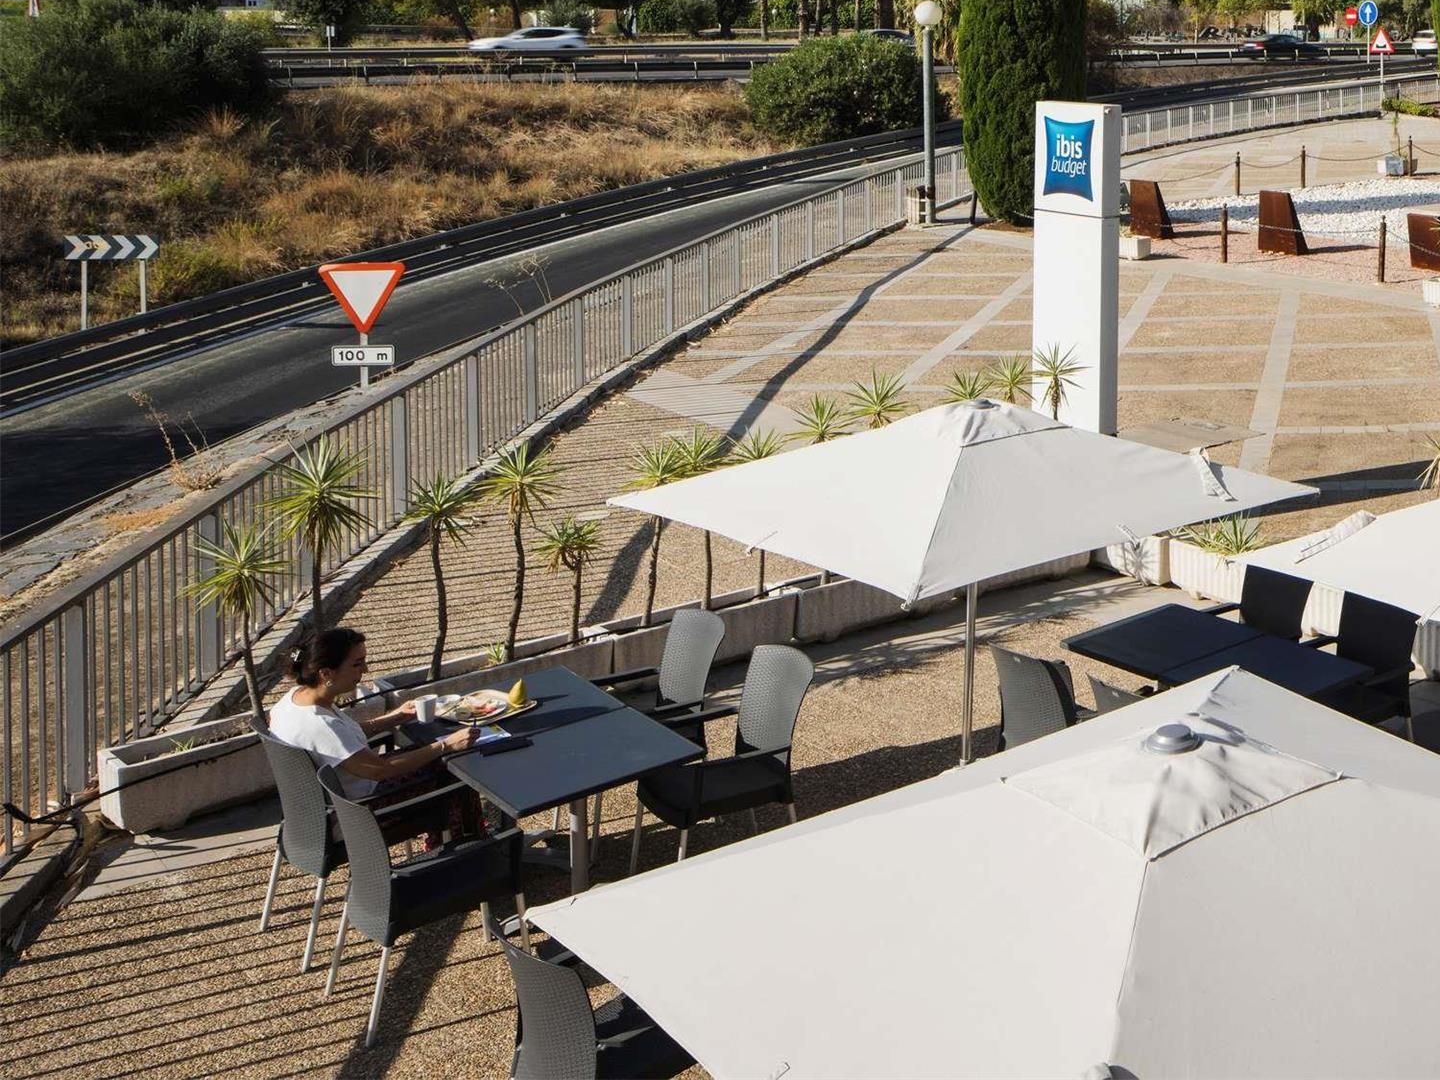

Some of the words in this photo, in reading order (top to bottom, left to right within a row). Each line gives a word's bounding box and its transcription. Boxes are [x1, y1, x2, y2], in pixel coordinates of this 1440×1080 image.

[1056, 133, 1083, 159] ibis
[1051, 156, 1087, 178] budget
[338, 350, 365, 361] 100
[376, 352, 388, 361] m
